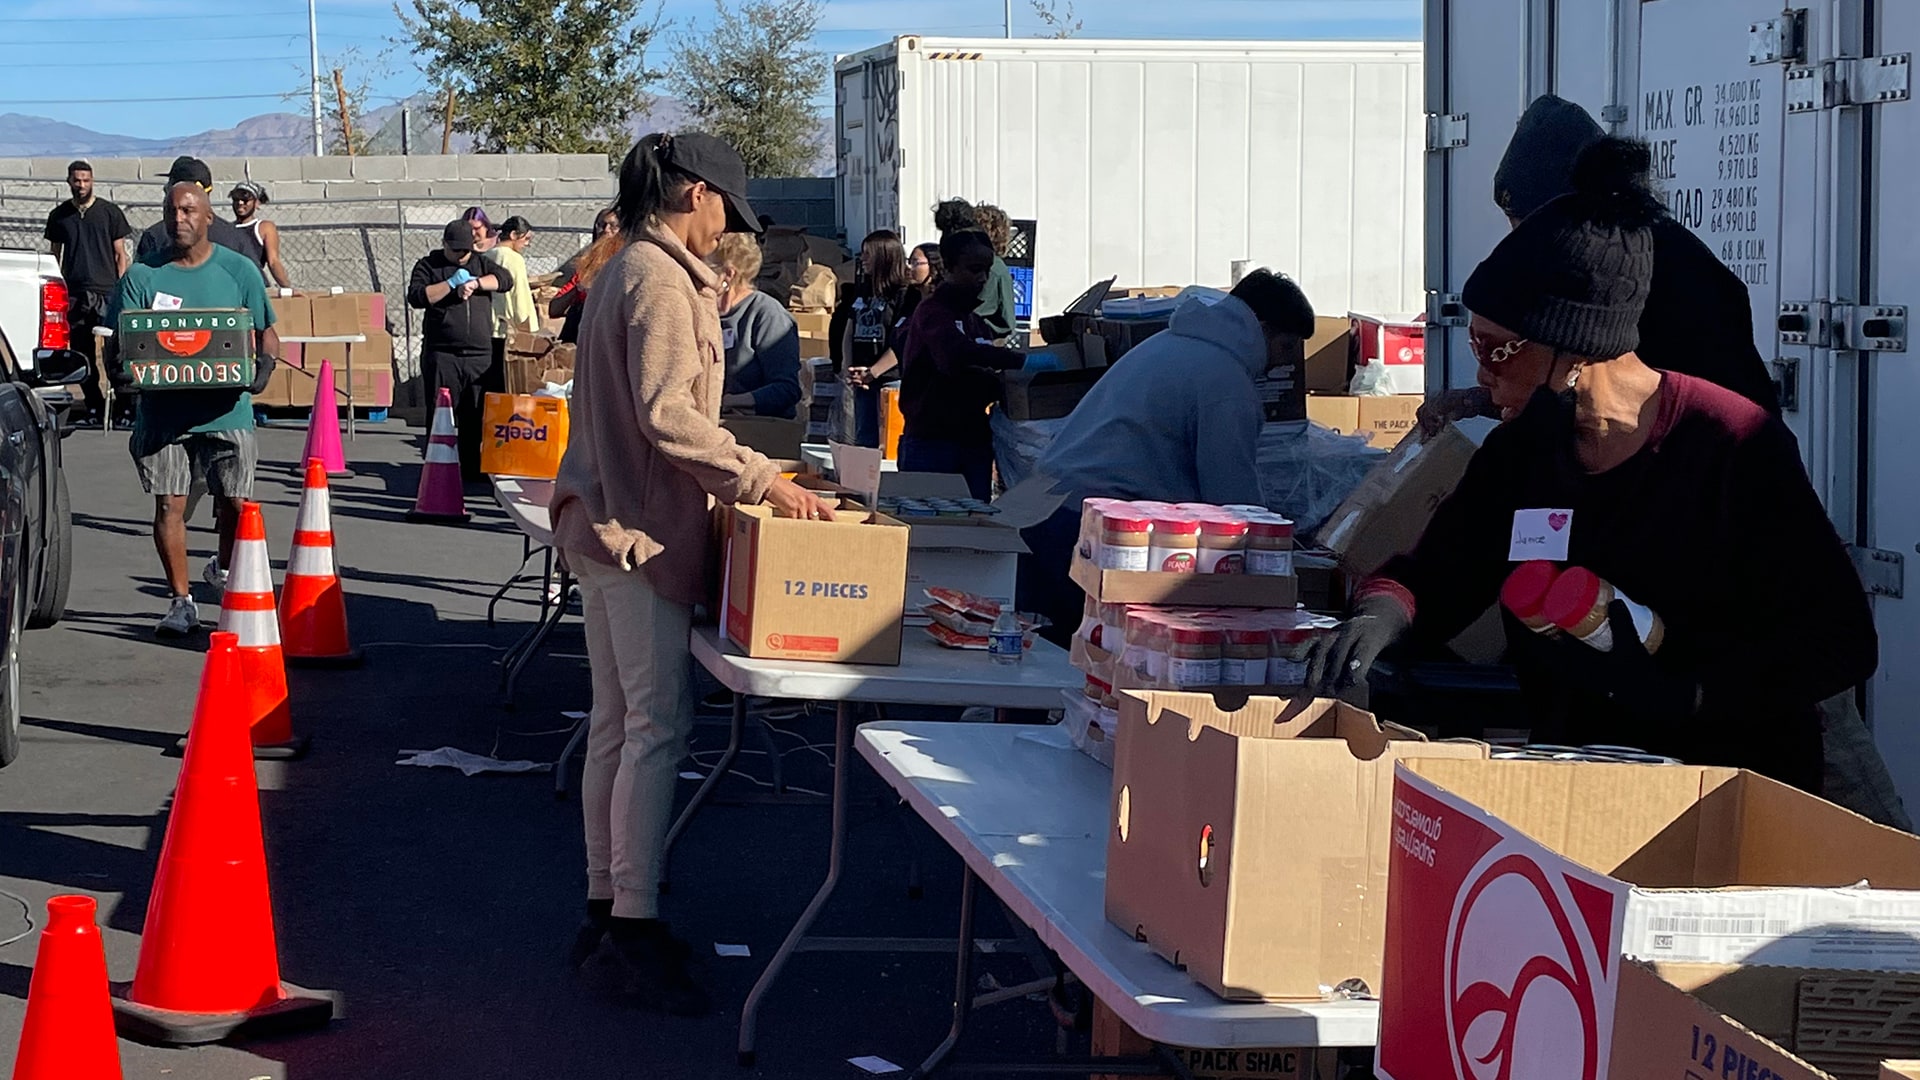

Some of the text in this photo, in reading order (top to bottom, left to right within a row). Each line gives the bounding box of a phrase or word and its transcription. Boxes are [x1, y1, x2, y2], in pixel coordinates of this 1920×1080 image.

[1749, 79, 1760, 100] KG
[1645, 85, 1705, 131] MAX. GR.
[1749, 103, 1760, 125] LB
[1747, 132, 1759, 154] KG
[1650, 139, 1677, 179] ARE
[1747, 157, 1758, 178] LB
[1746, 186, 1757, 207] KG
[1746, 210, 1756, 231] LB
[131, 317, 236, 329] ORANGES
[130, 361, 241, 384] SEQUOIA
[494, 425, 547, 443] peelz
[1374, 420, 1387, 429] THE
[1389, 420, 1409, 429] PACK
[784, 580, 868, 599] 12 PIECES
[1691, 1024, 1716, 1072] 12
[1189, 1051, 1240, 1072] PACK
